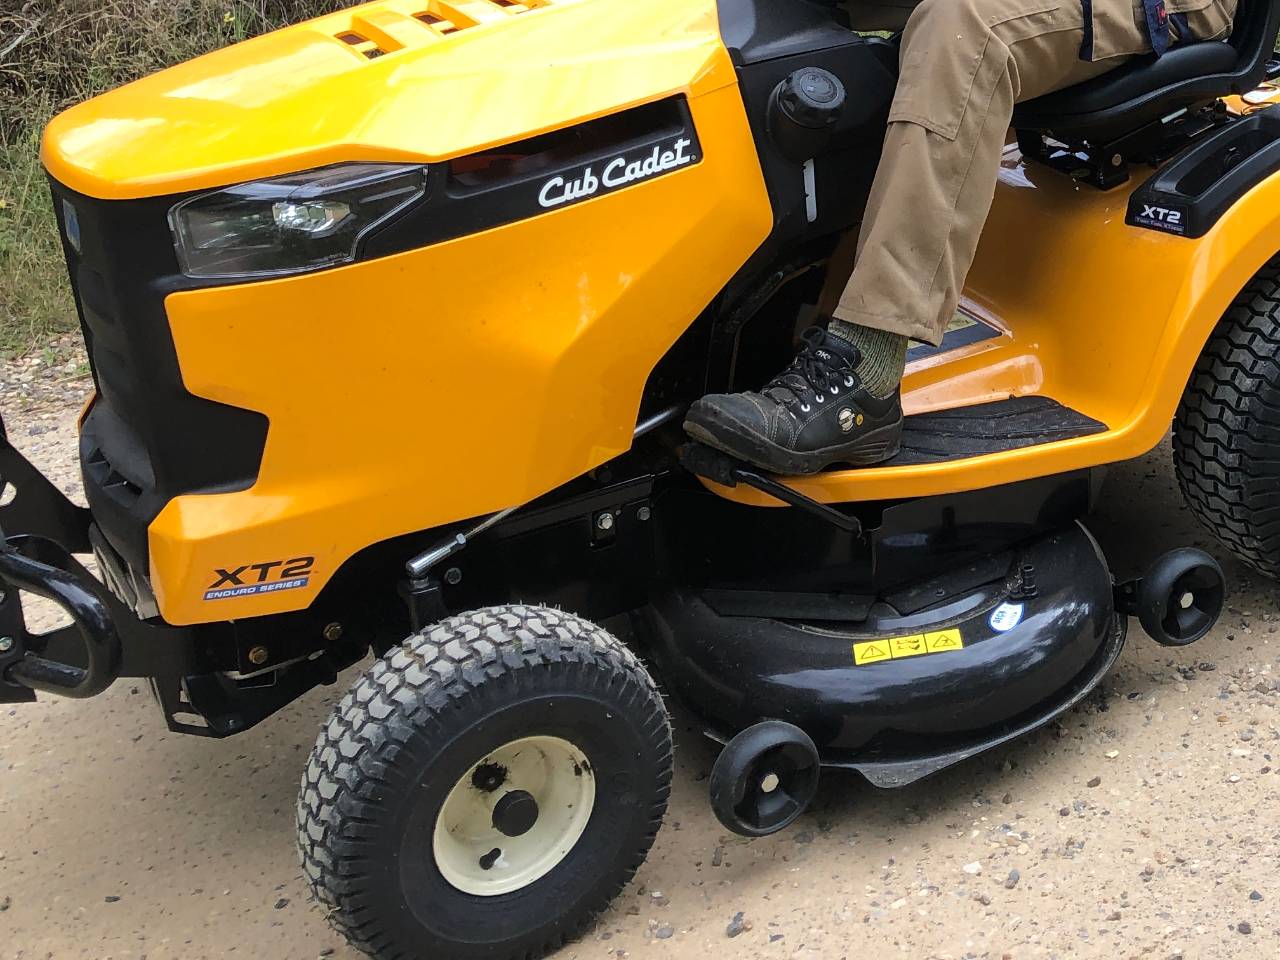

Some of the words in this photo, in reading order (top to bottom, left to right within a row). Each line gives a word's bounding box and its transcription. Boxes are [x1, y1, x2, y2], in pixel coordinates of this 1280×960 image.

[538, 167, 599, 208] Cub
[602, 138, 691, 188] Cadet
[1140, 204, 1181, 224] XT2
[207, 556, 315, 589] XT2
[206, 587, 257, 599] ENDURO
[259, 580, 302, 593] SERIES
